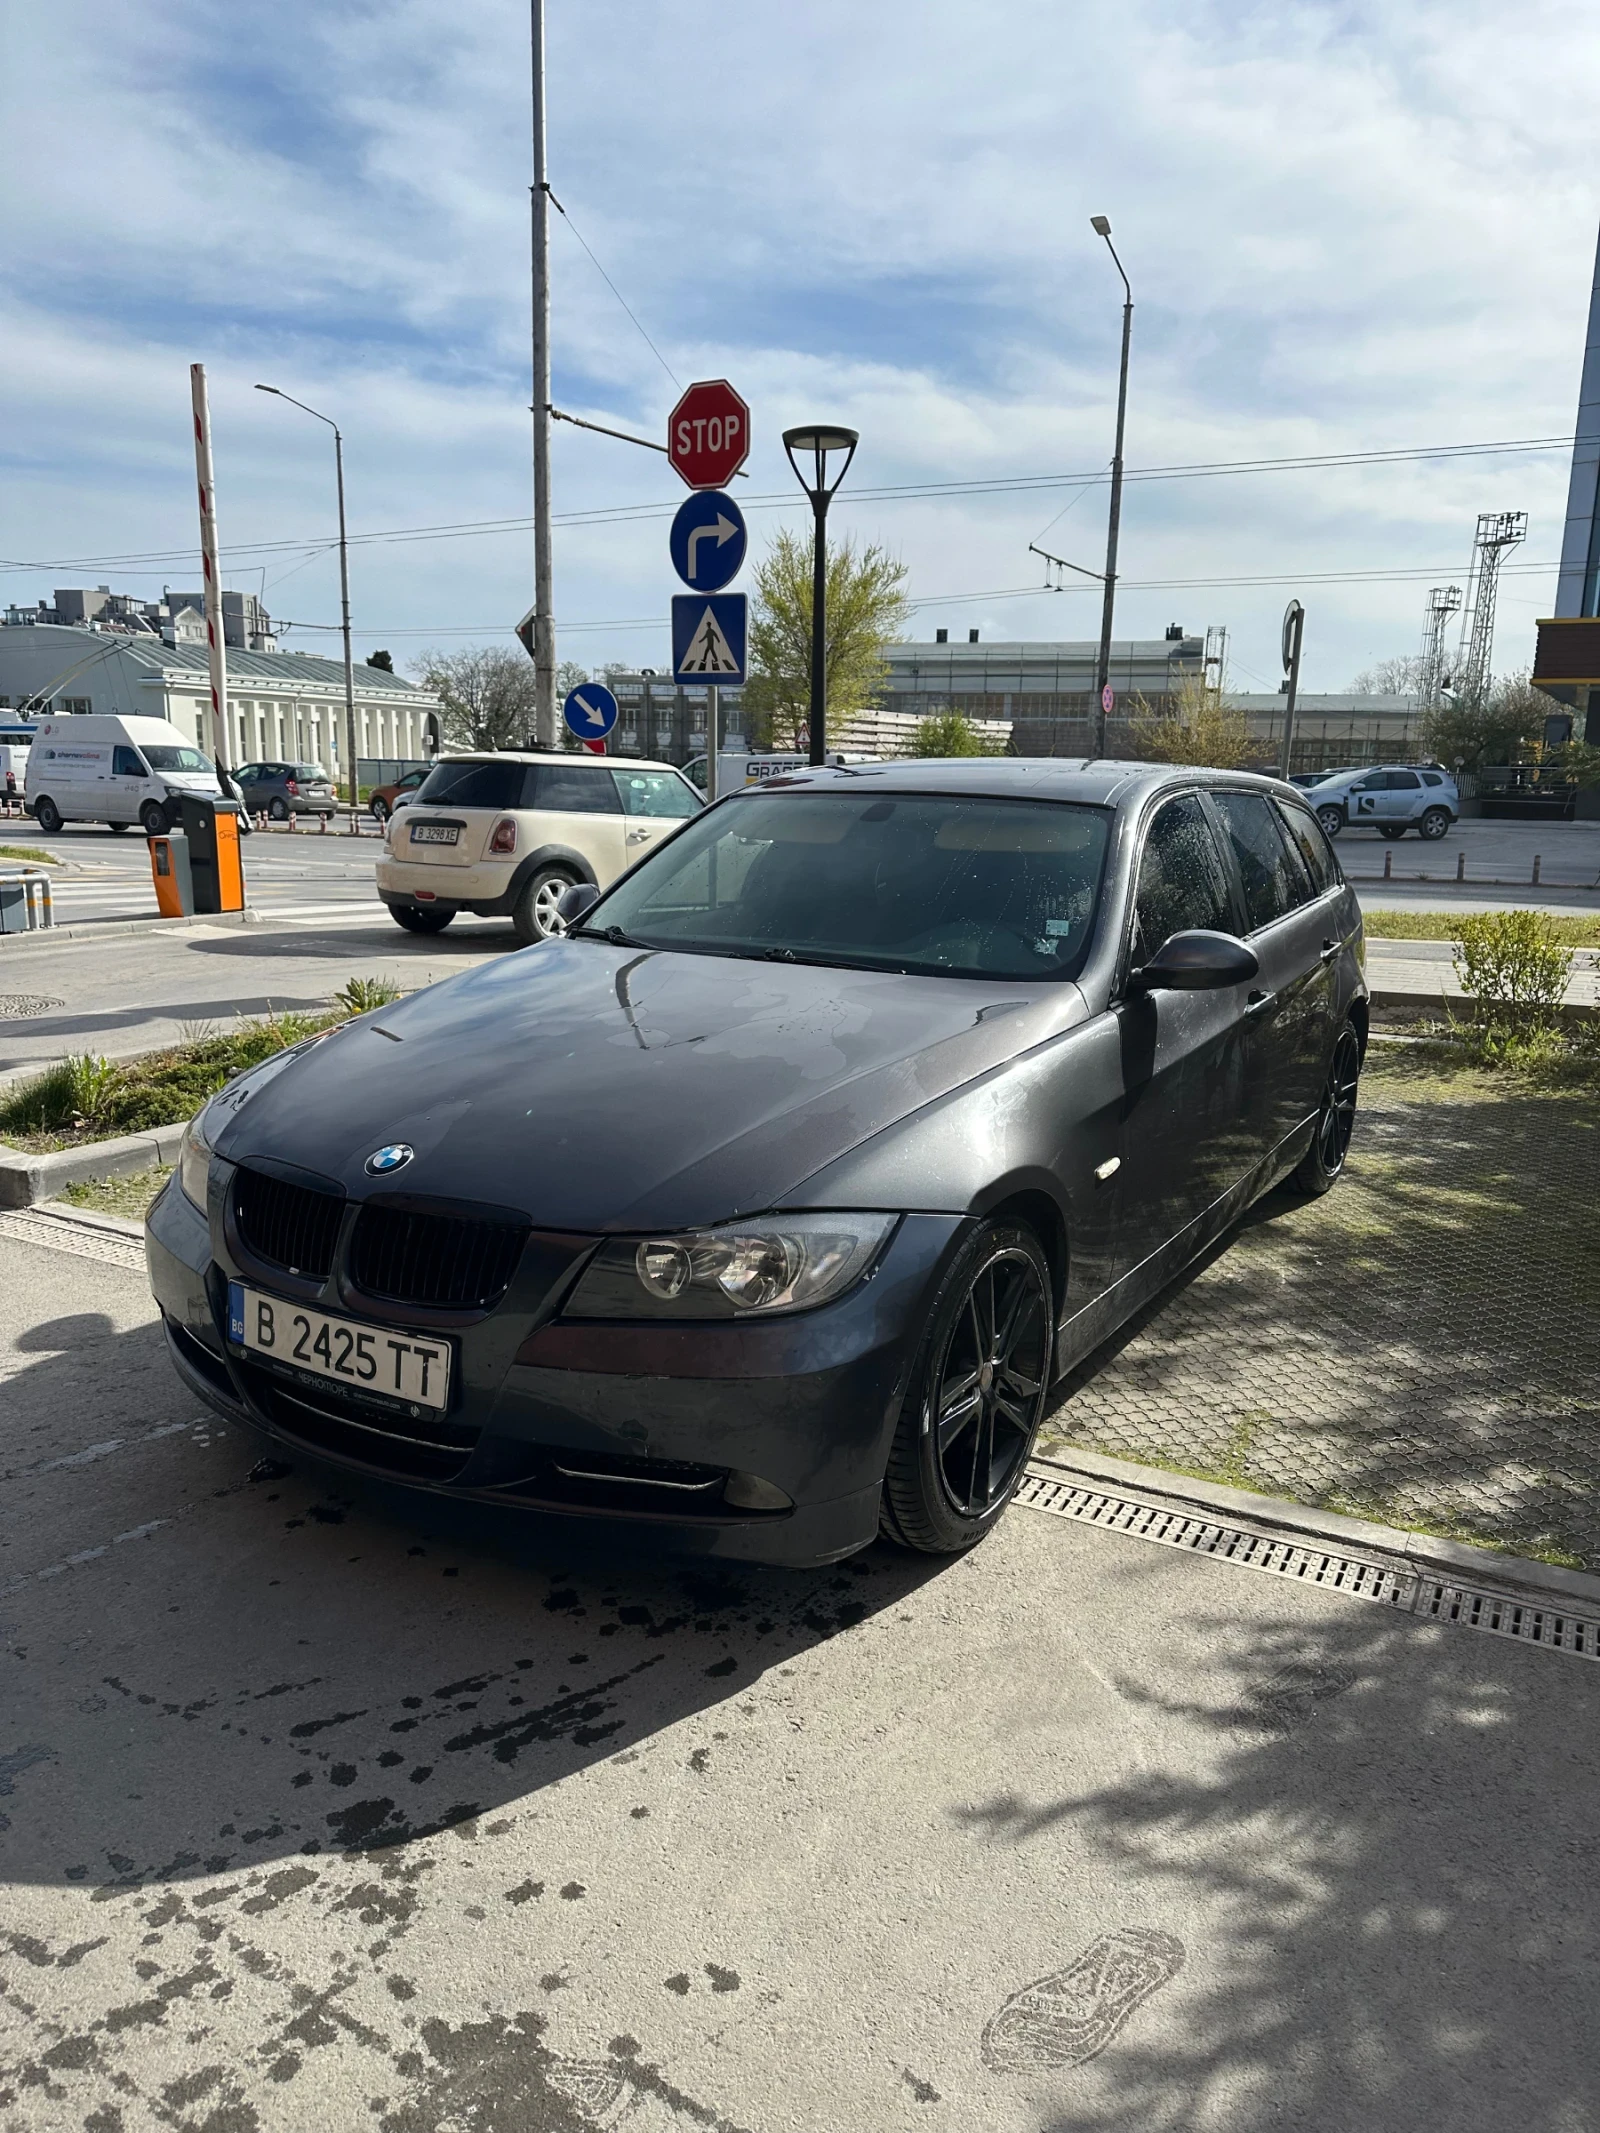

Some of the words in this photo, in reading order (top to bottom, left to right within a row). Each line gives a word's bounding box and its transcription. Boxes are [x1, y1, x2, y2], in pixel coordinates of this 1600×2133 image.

[677, 415, 740, 455] STOP
[418, 828, 424, 838] B
[231, 1318, 244, 1335] BG
[258, 1300, 275, 1347] B
[293, 1314, 377, 1381] 2425
[387, 1340, 439, 1396] TT
